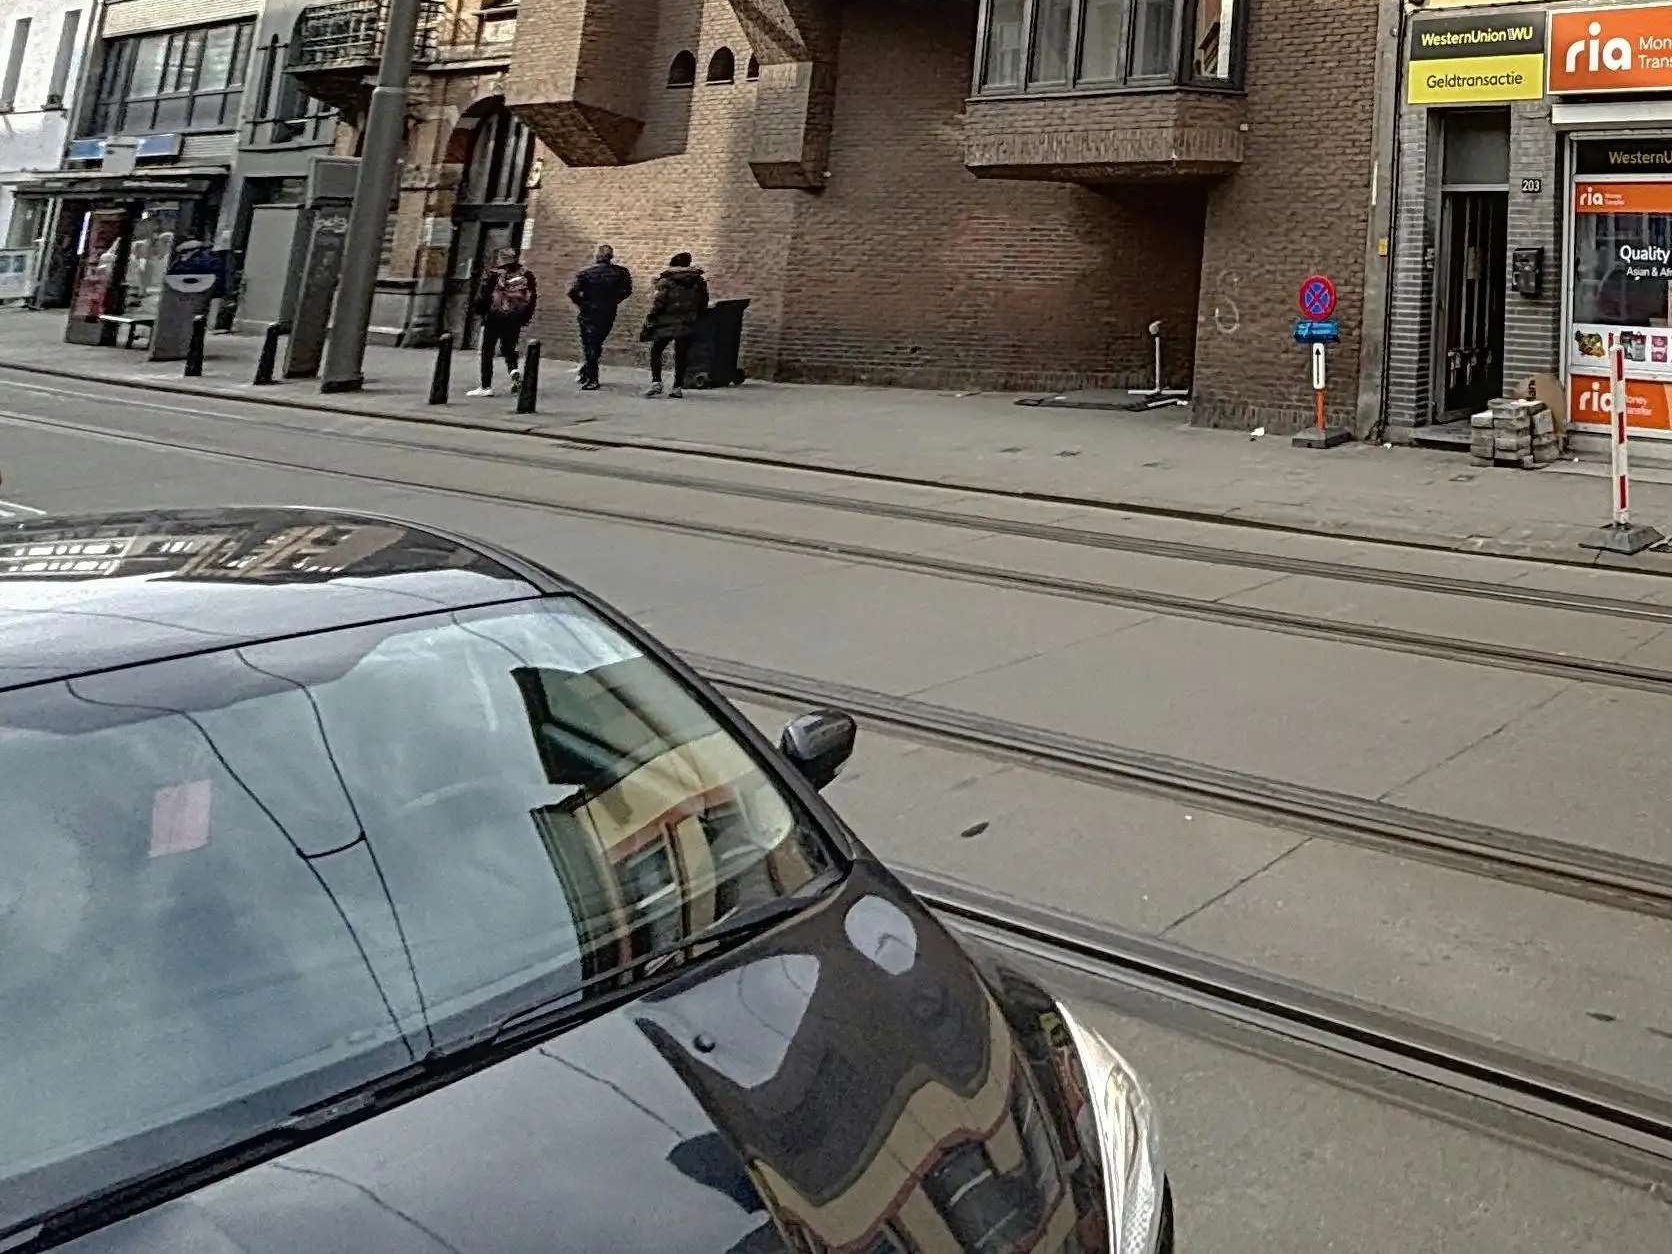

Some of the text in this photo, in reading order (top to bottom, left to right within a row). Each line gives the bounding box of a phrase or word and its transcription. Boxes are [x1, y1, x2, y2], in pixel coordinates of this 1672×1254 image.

[1565, 21, 1632, 73] ria
[1426, 70, 1523, 89] Geldtransactie
[1522, 179, 1540, 192] 203
[1580, 186, 1604, 206] ria
[1620, 245, 1671, 264] Quality
[1626, 266, 1650, 277] Asian
[1651, 267, 1659, 277] &
